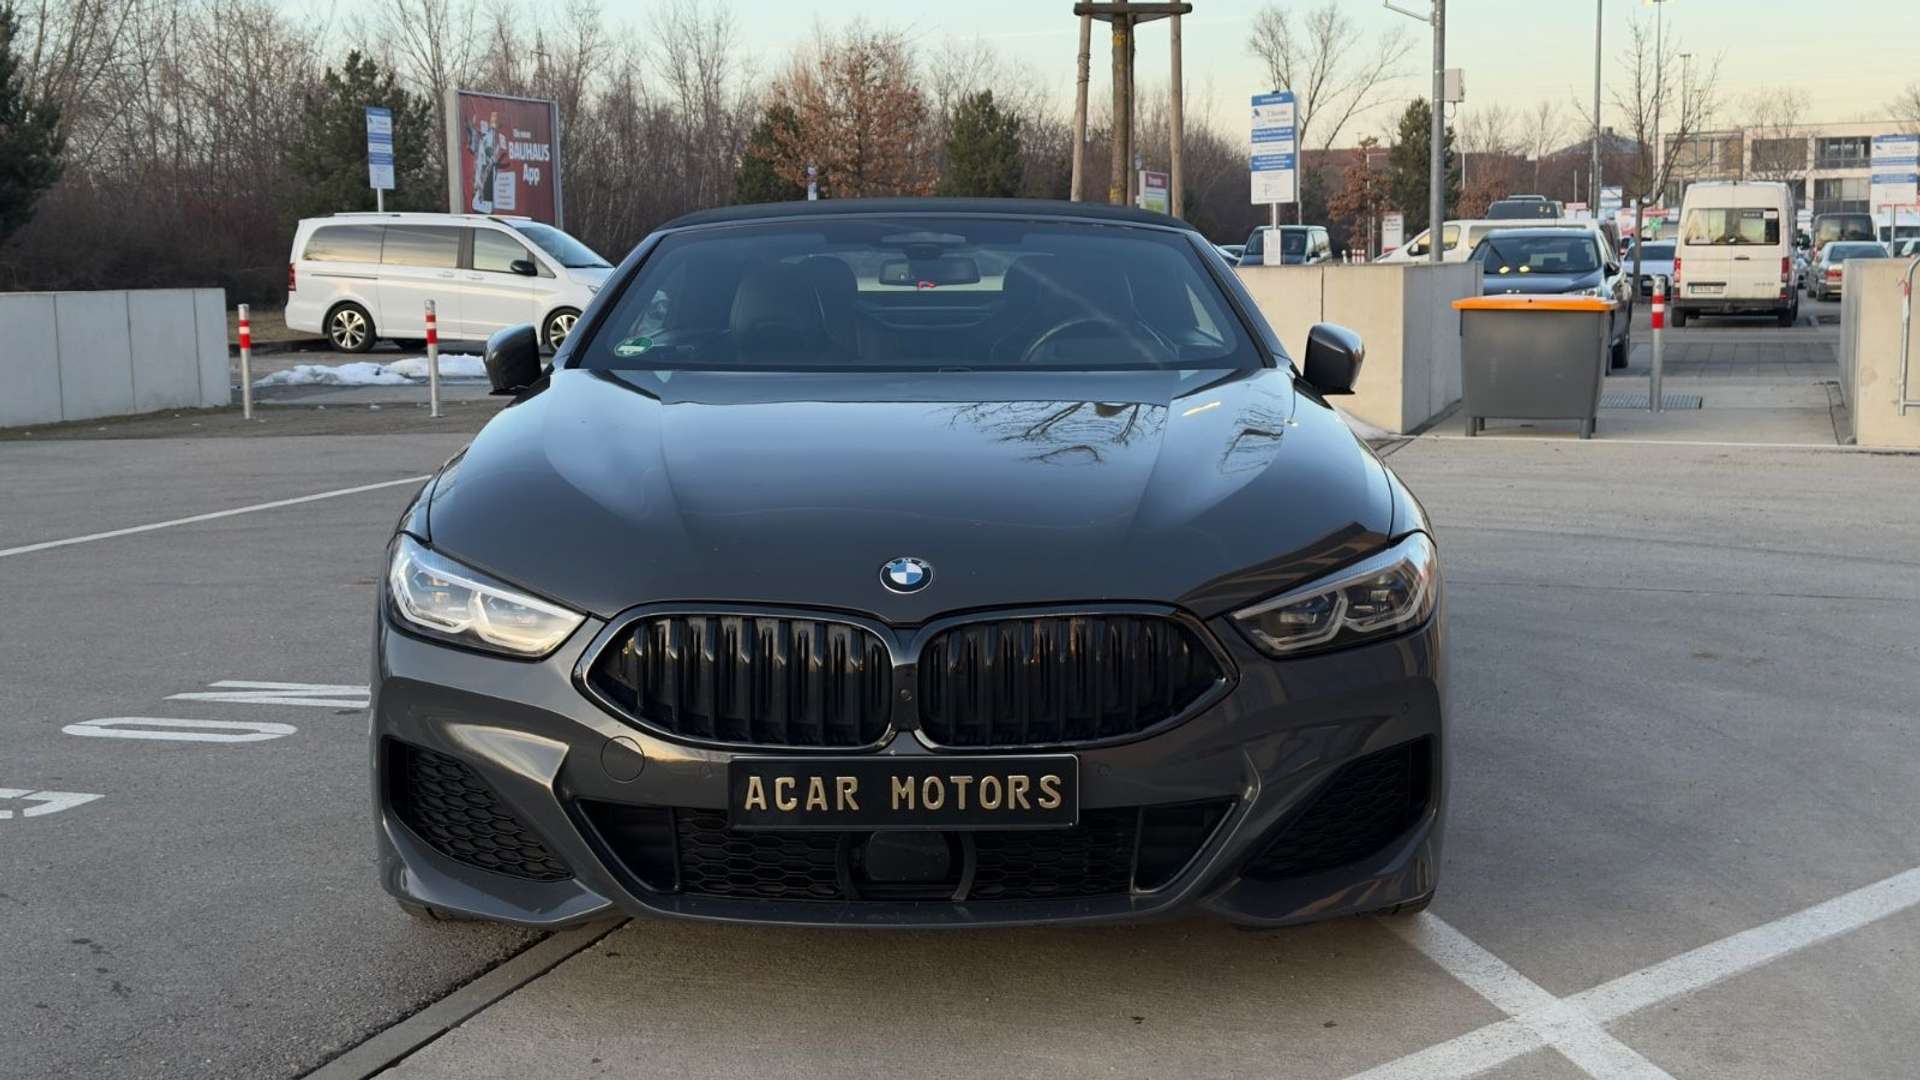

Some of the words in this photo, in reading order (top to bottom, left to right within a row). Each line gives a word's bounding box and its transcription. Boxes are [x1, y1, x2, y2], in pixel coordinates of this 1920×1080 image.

[508, 141, 551, 162] BAUHAUS
[523, 163, 541, 187] App
[744, 775, 860, 811] ACAR
[891, 775, 1062, 811] MOTORS
